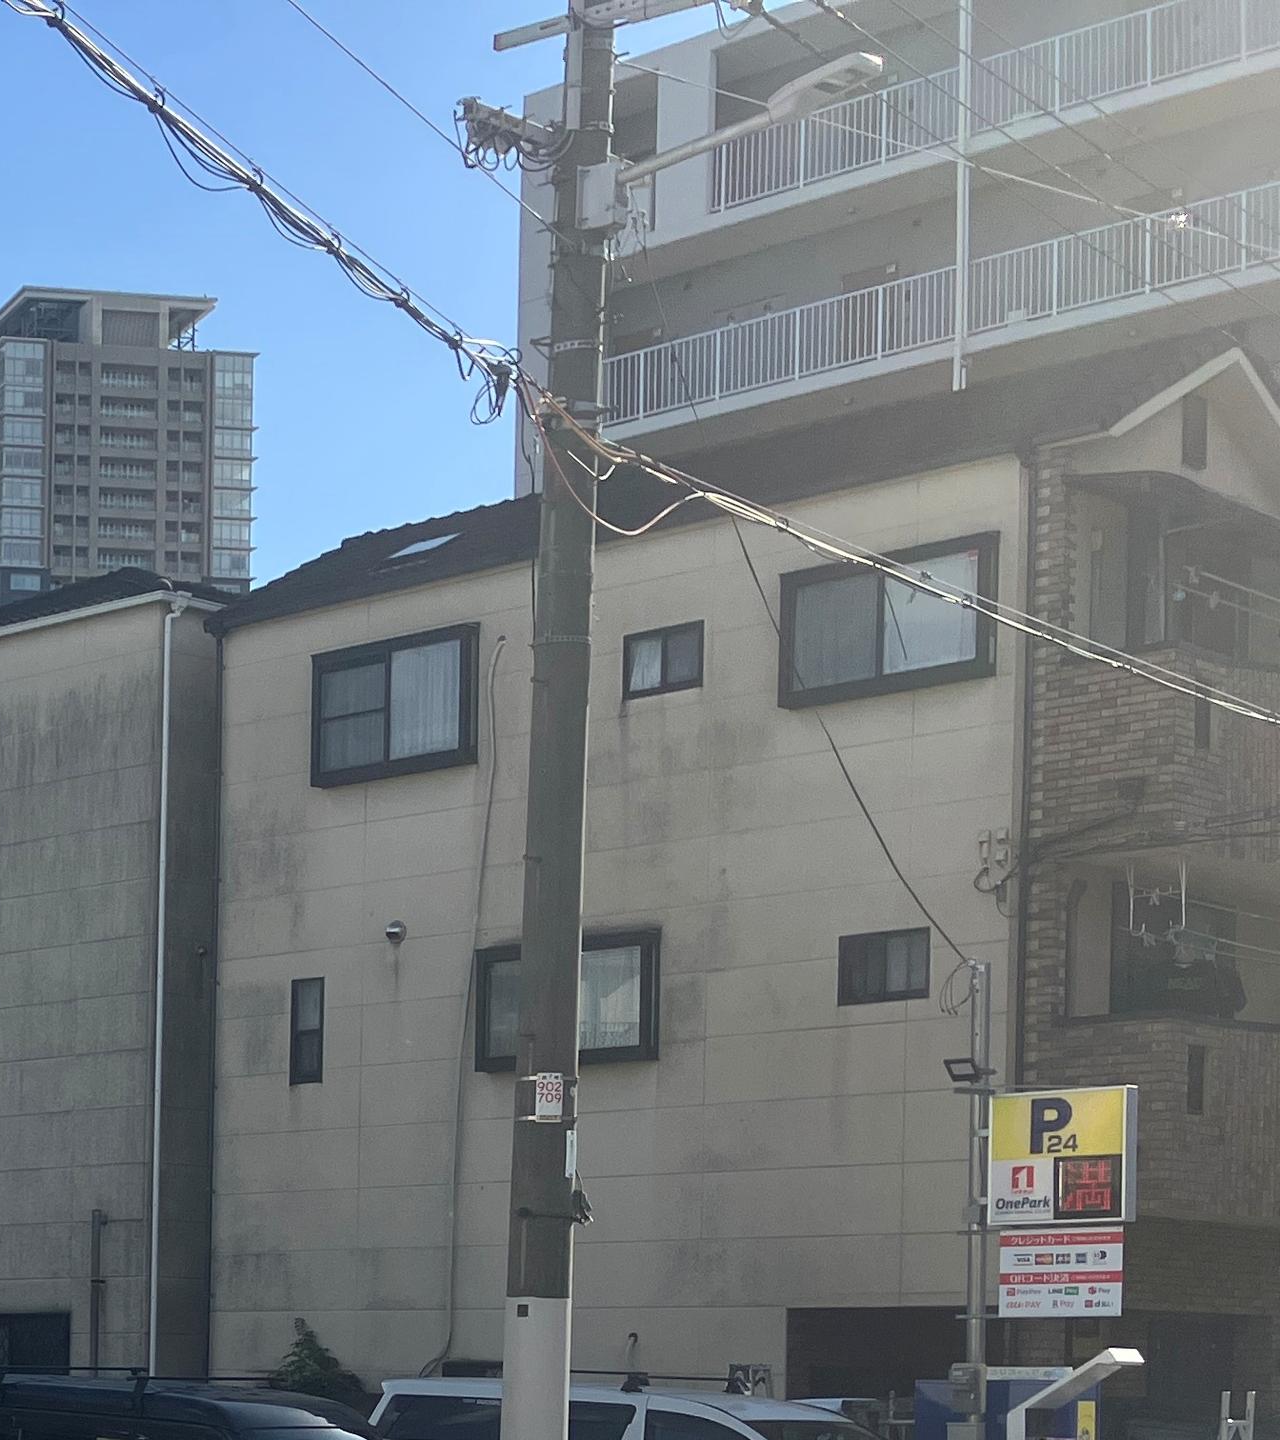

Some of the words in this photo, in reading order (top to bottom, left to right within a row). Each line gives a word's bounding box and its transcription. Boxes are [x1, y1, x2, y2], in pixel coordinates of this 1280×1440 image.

[537, 1081, 561, 1092] 902
[537, 1092, 561, 1103] 709
[1030, 1097, 1073, 1154] P
[1047, 1134, 1078, 1153] 24
[995, 1196, 1051, 1210] OnePark
